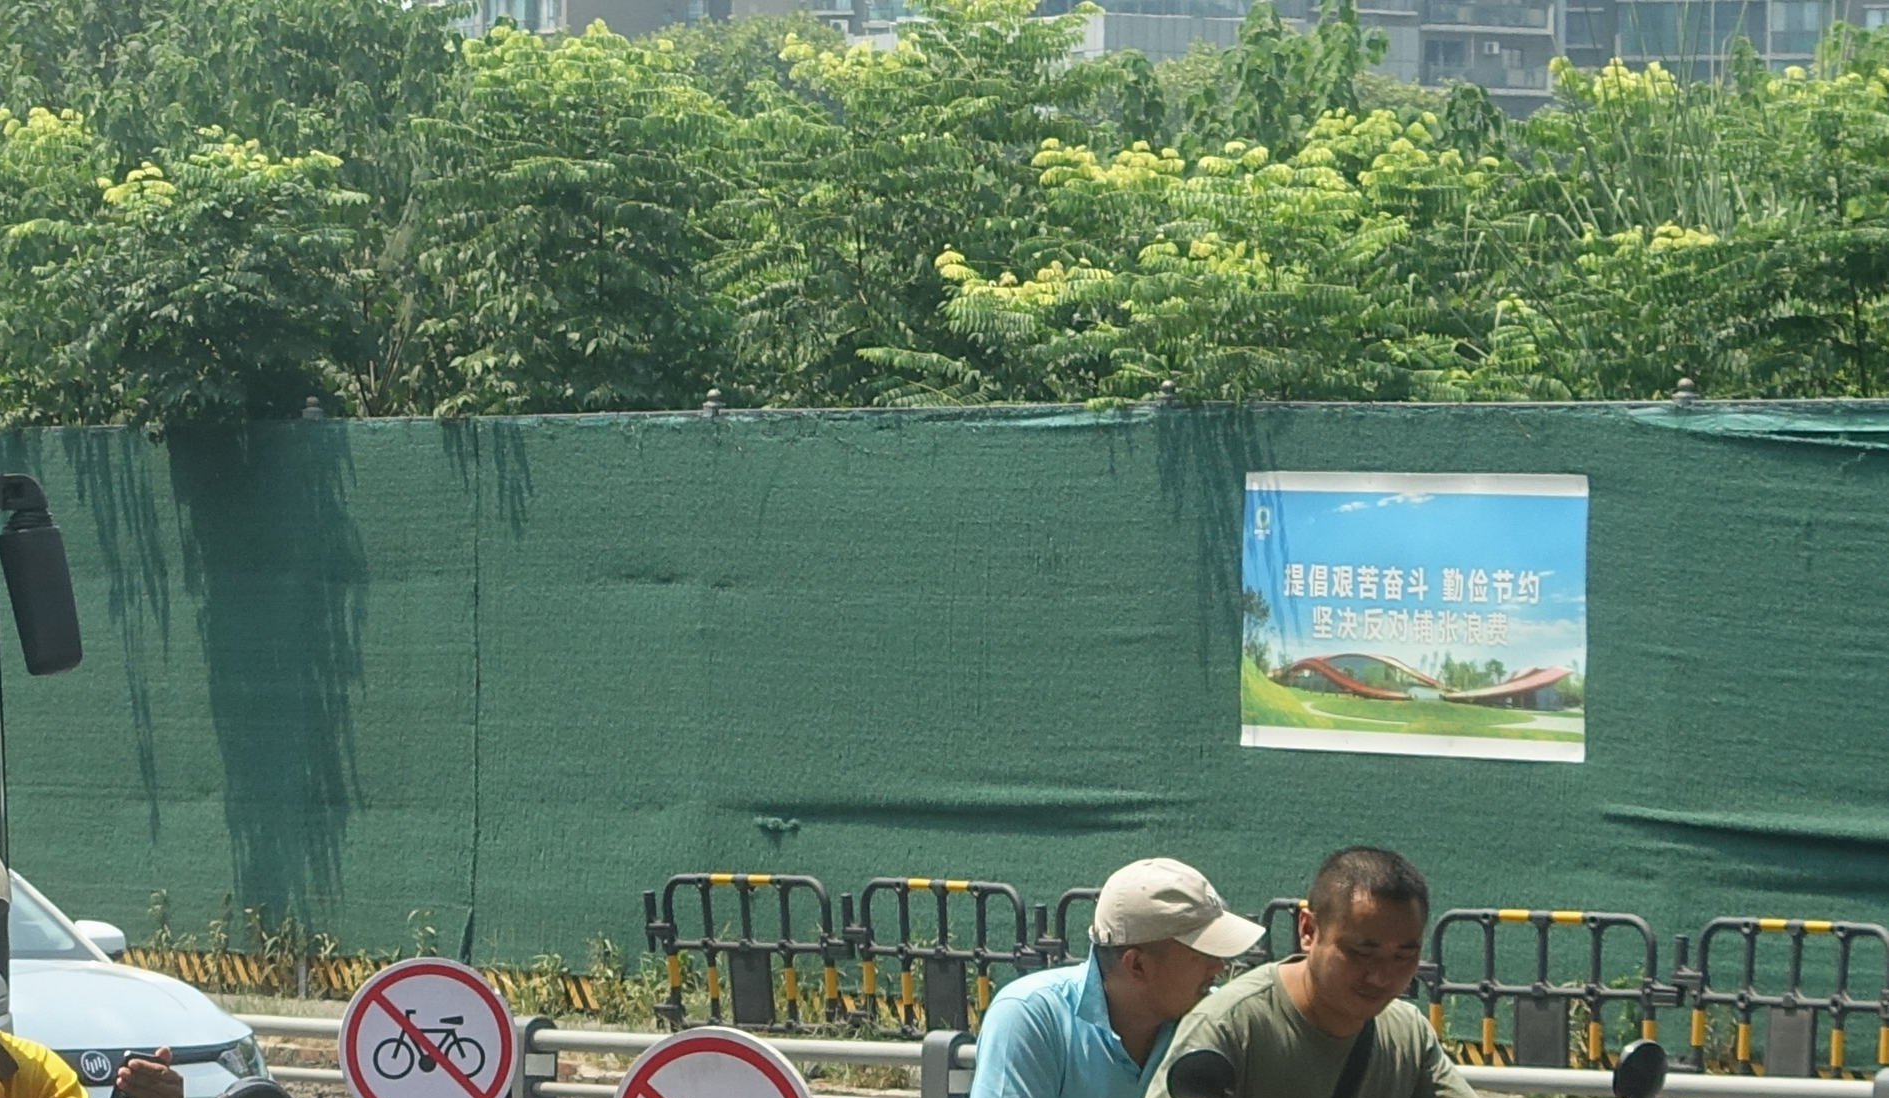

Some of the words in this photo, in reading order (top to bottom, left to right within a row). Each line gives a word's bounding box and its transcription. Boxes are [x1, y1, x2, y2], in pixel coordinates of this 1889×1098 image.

[1283, 563, 1429, 601] 提倡艰苦奋斗
[1441, 567, 1540, 605] 勤俭节约
[1312, 605, 1509, 646] 坚决反对铺张浪费
